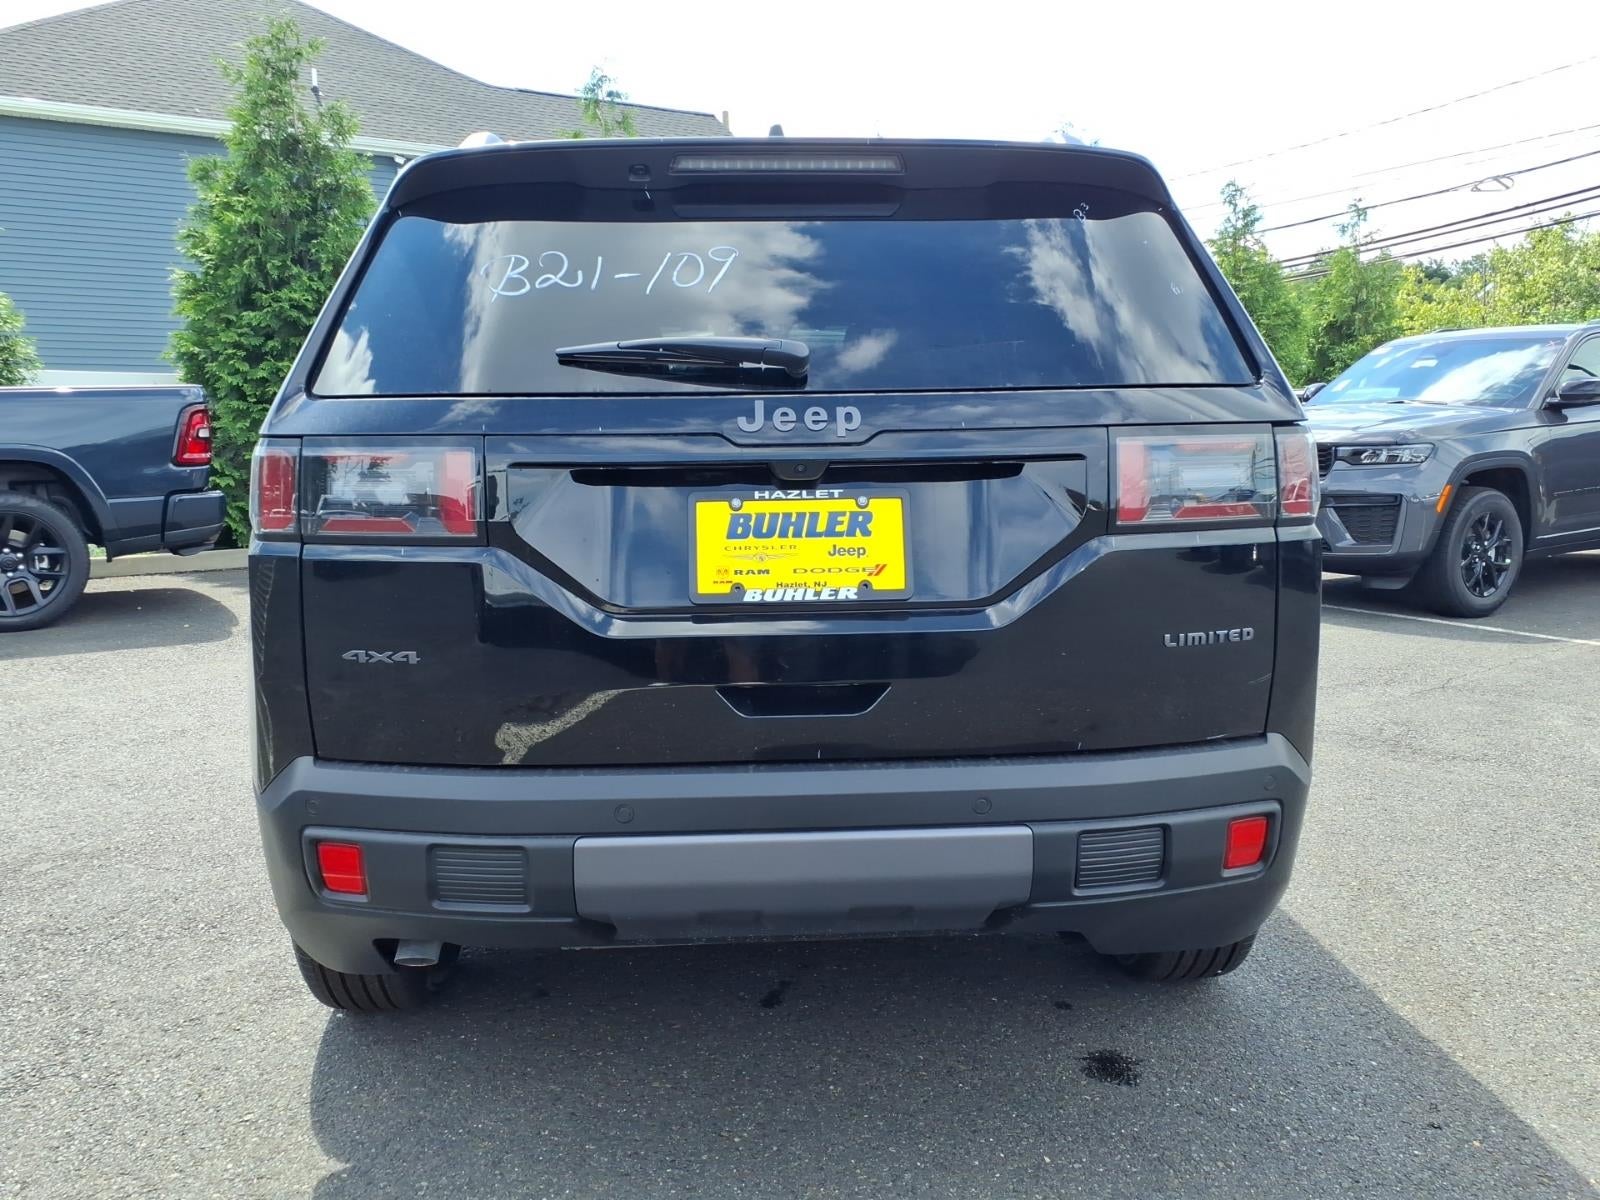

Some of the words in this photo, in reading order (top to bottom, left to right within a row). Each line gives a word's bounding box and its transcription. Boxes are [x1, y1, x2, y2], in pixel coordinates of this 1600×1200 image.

[480, 246, 739, 303] B21-109
[737, 400, 861, 437] Jeep
[754, 489, 844, 499] HAZLET
[726, 511, 873, 539] BUHLER
[724, 544, 798, 552] CHRYSLER
[828, 544, 866, 559] Jeep
[734, 568, 770, 576] RAM
[793, 566, 877, 574] DODGE
[813, 580, 827, 588] NJ
[743, 587, 858, 601] BUHLER
[1164, 627, 1254, 647] LIMITED
